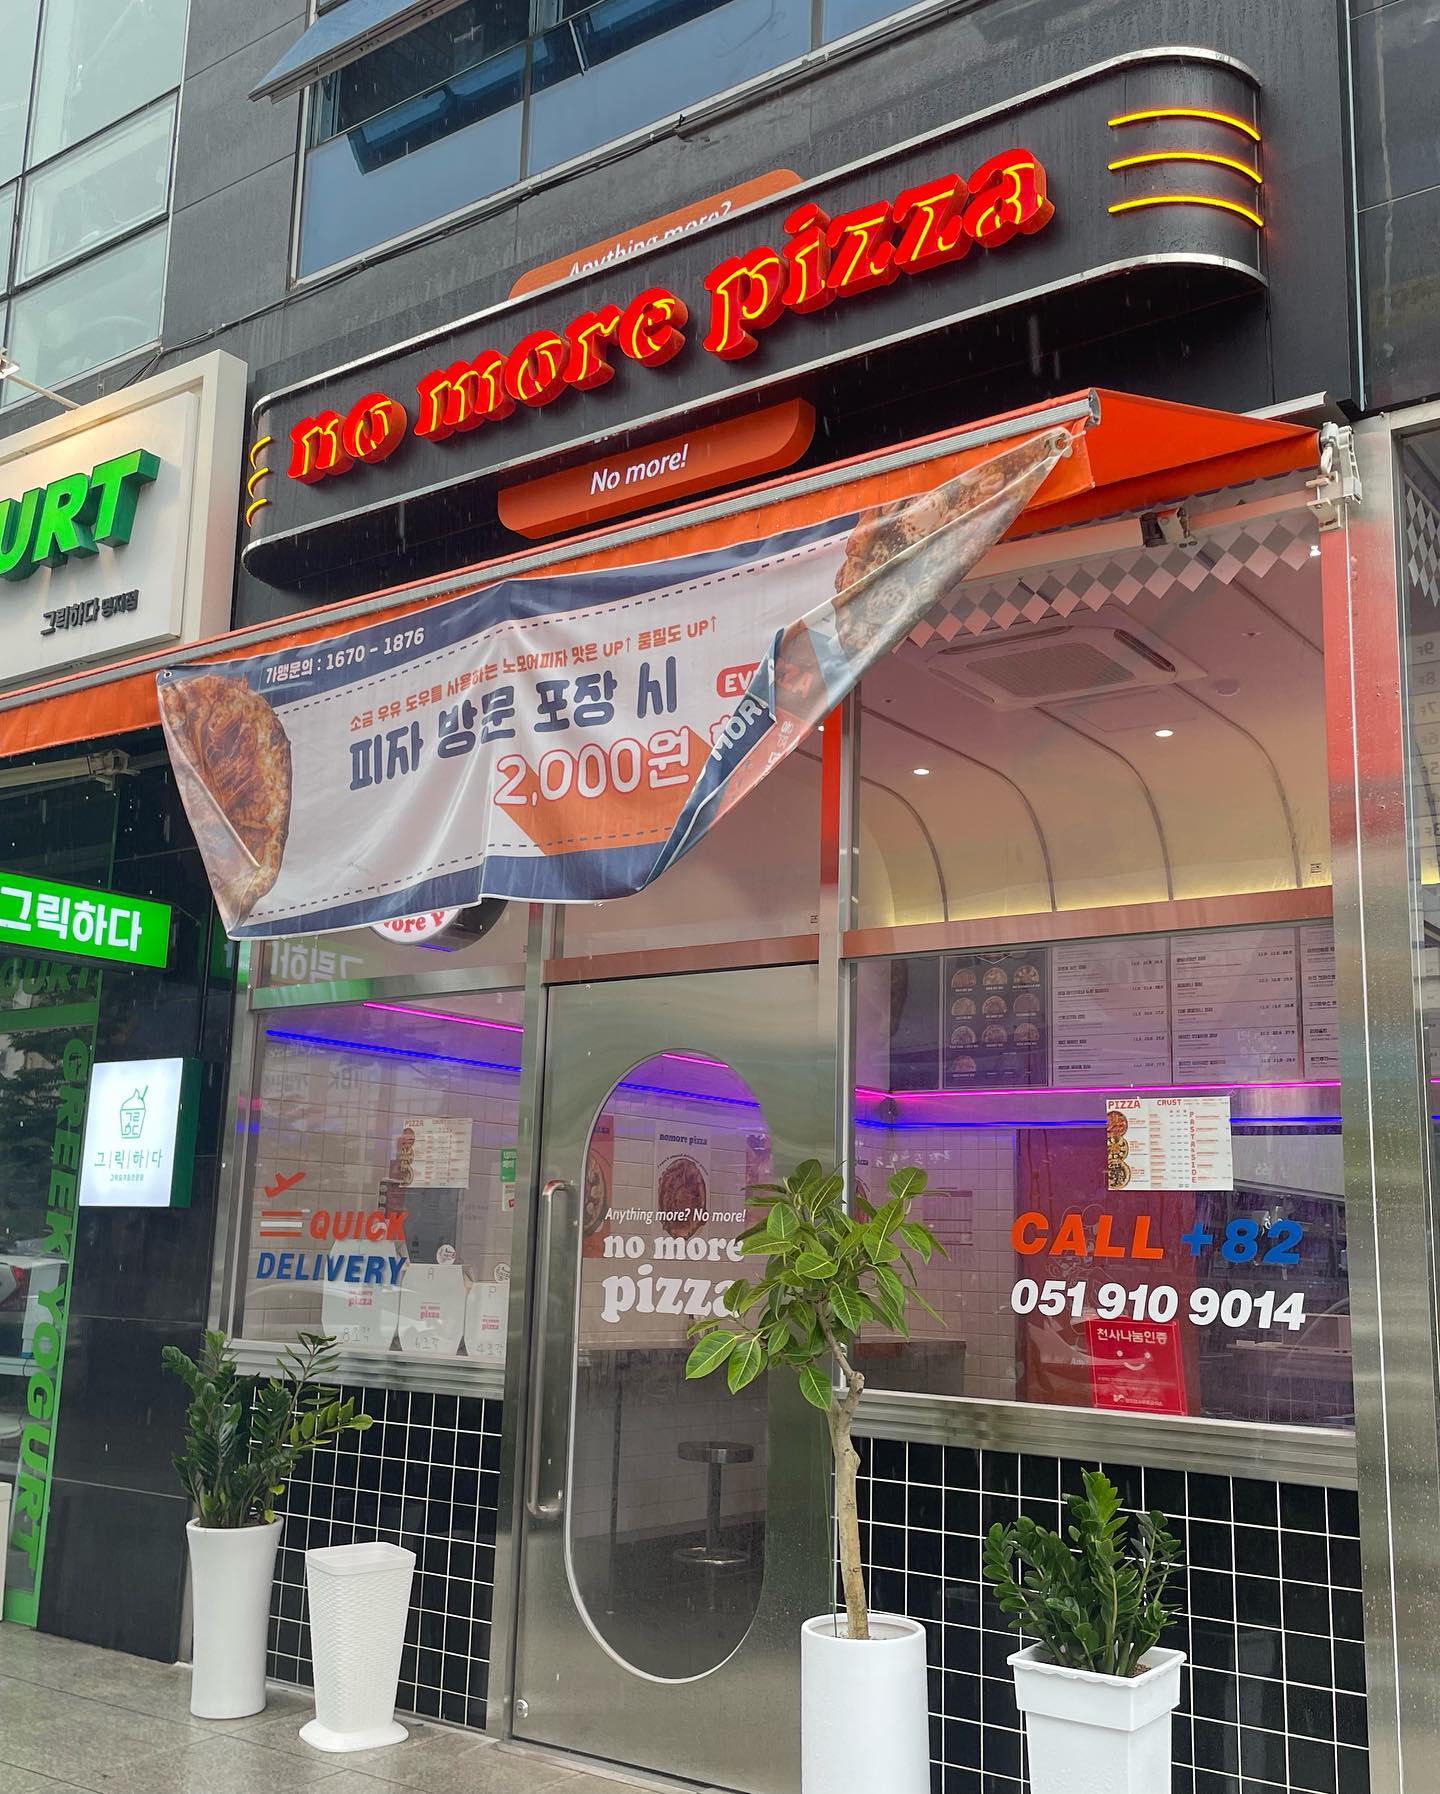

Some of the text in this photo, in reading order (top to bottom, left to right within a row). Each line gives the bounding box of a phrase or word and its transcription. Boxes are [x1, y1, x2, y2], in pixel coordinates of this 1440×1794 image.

[287, 147, 1056, 485] no more pizza
[589, 444, 689, 495] No more!
[266, 657, 313, 683] 가맹문의
[326, 645, 366, 670] 1670
[383, 627, 425, 655] 1876
[350, 710, 374, 732] 소금
[378, 701, 402, 722] 우유
[406, 684, 442, 712] 도우를
[447, 663, 498, 697] 사용하는
[503, 648, 568, 673] 노모어피자
[572, 643, 598, 665] 맛은
[638, 624, 681, 651] 품질도
[724, 670, 754, 693] EV
[349, 655, 677, 791] 피자 방문 포장 시
[493, 725, 691, 807] 2,000원
[0, 886, 142, 952] 그릭하다
[384, 916, 427, 933] ore
[1108, 1100, 1141, 1109] PIZZA
[43, 1038, 89, 1262] GREEK
[659, 1133, 708, 1145] nomore pizza
[308, 1210, 409, 1241] QUICK
[604, 1207, 746, 1225] Anything more? No more!
[1009, 1211, 1304, 1265] CALL +82
[256, 1252, 408, 1285] DELIVERY
[603, 1234, 745, 1262] no more
[1010, 1278, 1307, 1331] 051 910 9014
[1097, 1327, 1168, 1345] 천사나눔인증
[12, 1282, 65, 1571] YOGURT
